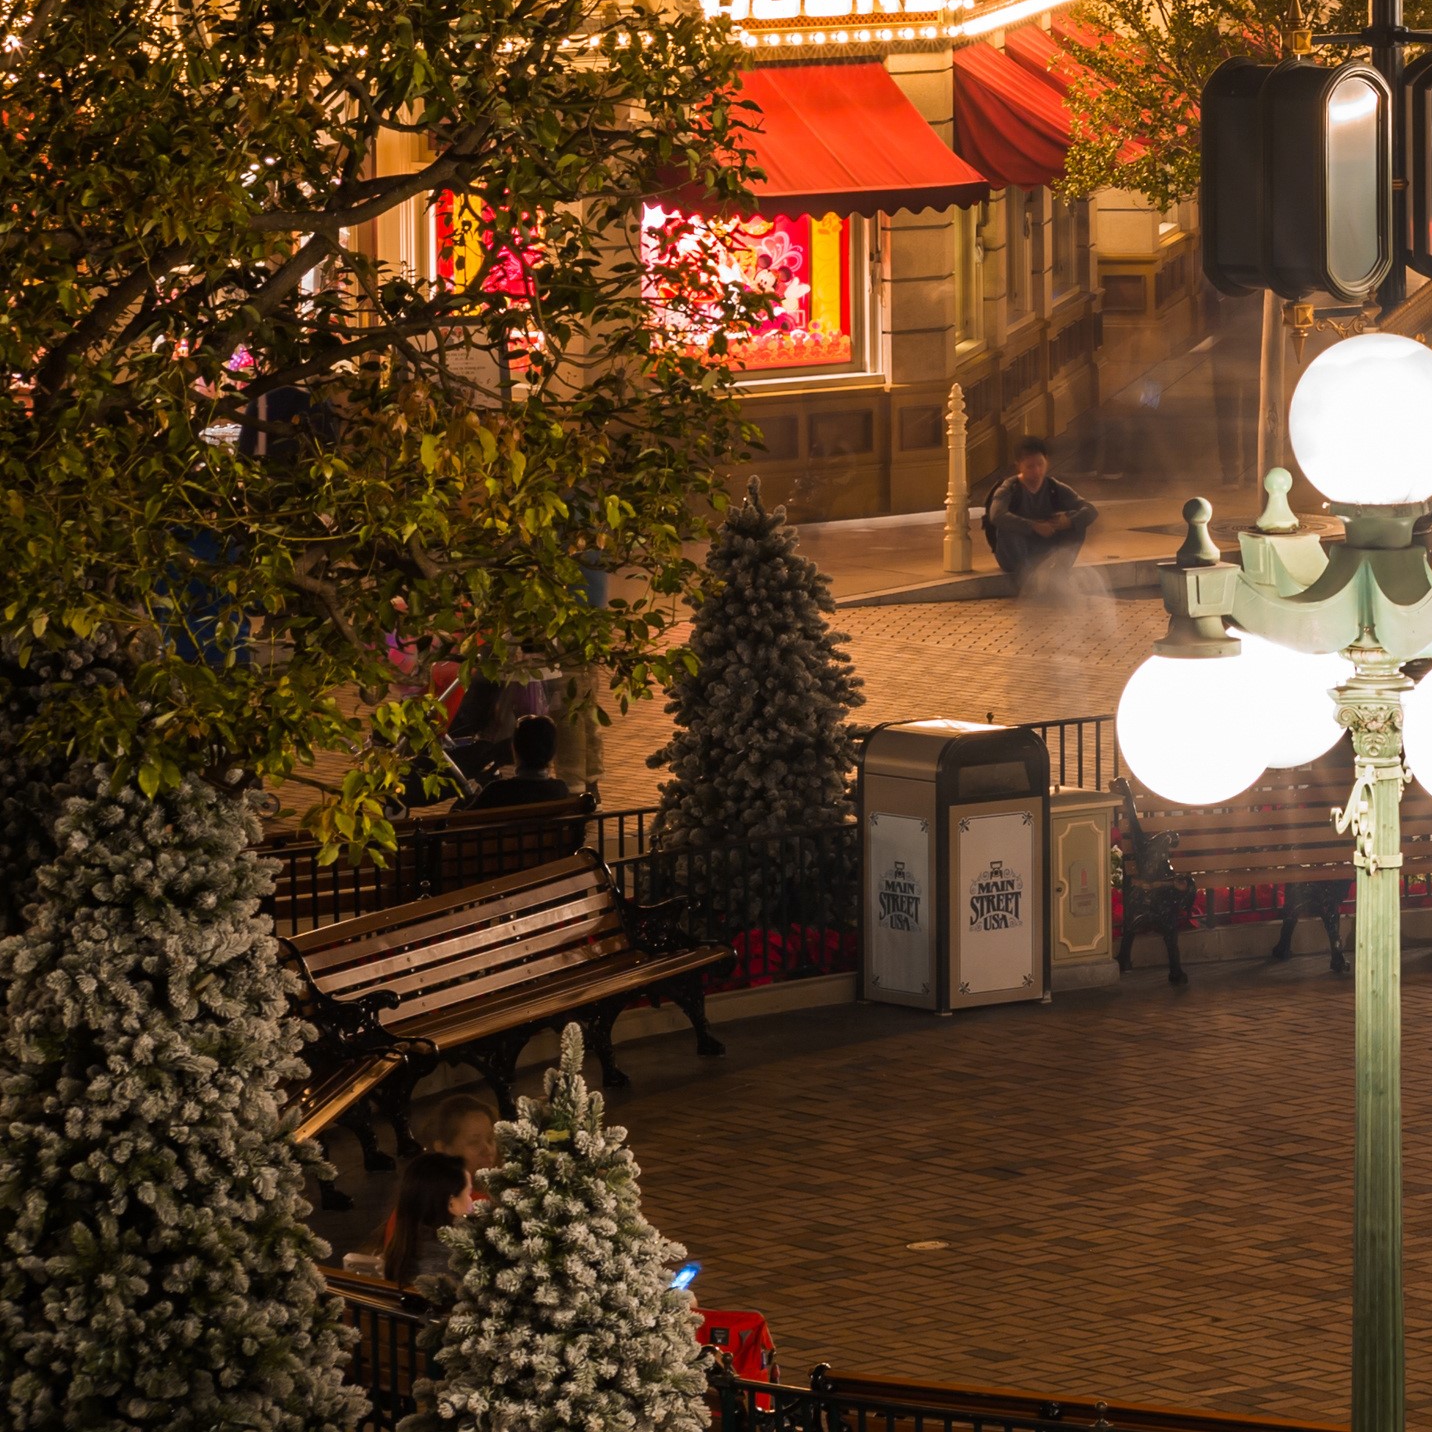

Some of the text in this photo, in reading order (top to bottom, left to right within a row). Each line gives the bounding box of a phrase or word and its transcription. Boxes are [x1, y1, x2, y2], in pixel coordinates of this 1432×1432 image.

[885, 879, 915, 895] MAIN
[978, 879, 1015, 895] MAIN
[879, 891, 920, 924] STREET
[970, 891, 1022, 925] STREET
[889, 914, 911, 931] USA
[983, 914, 1009, 931] USA
